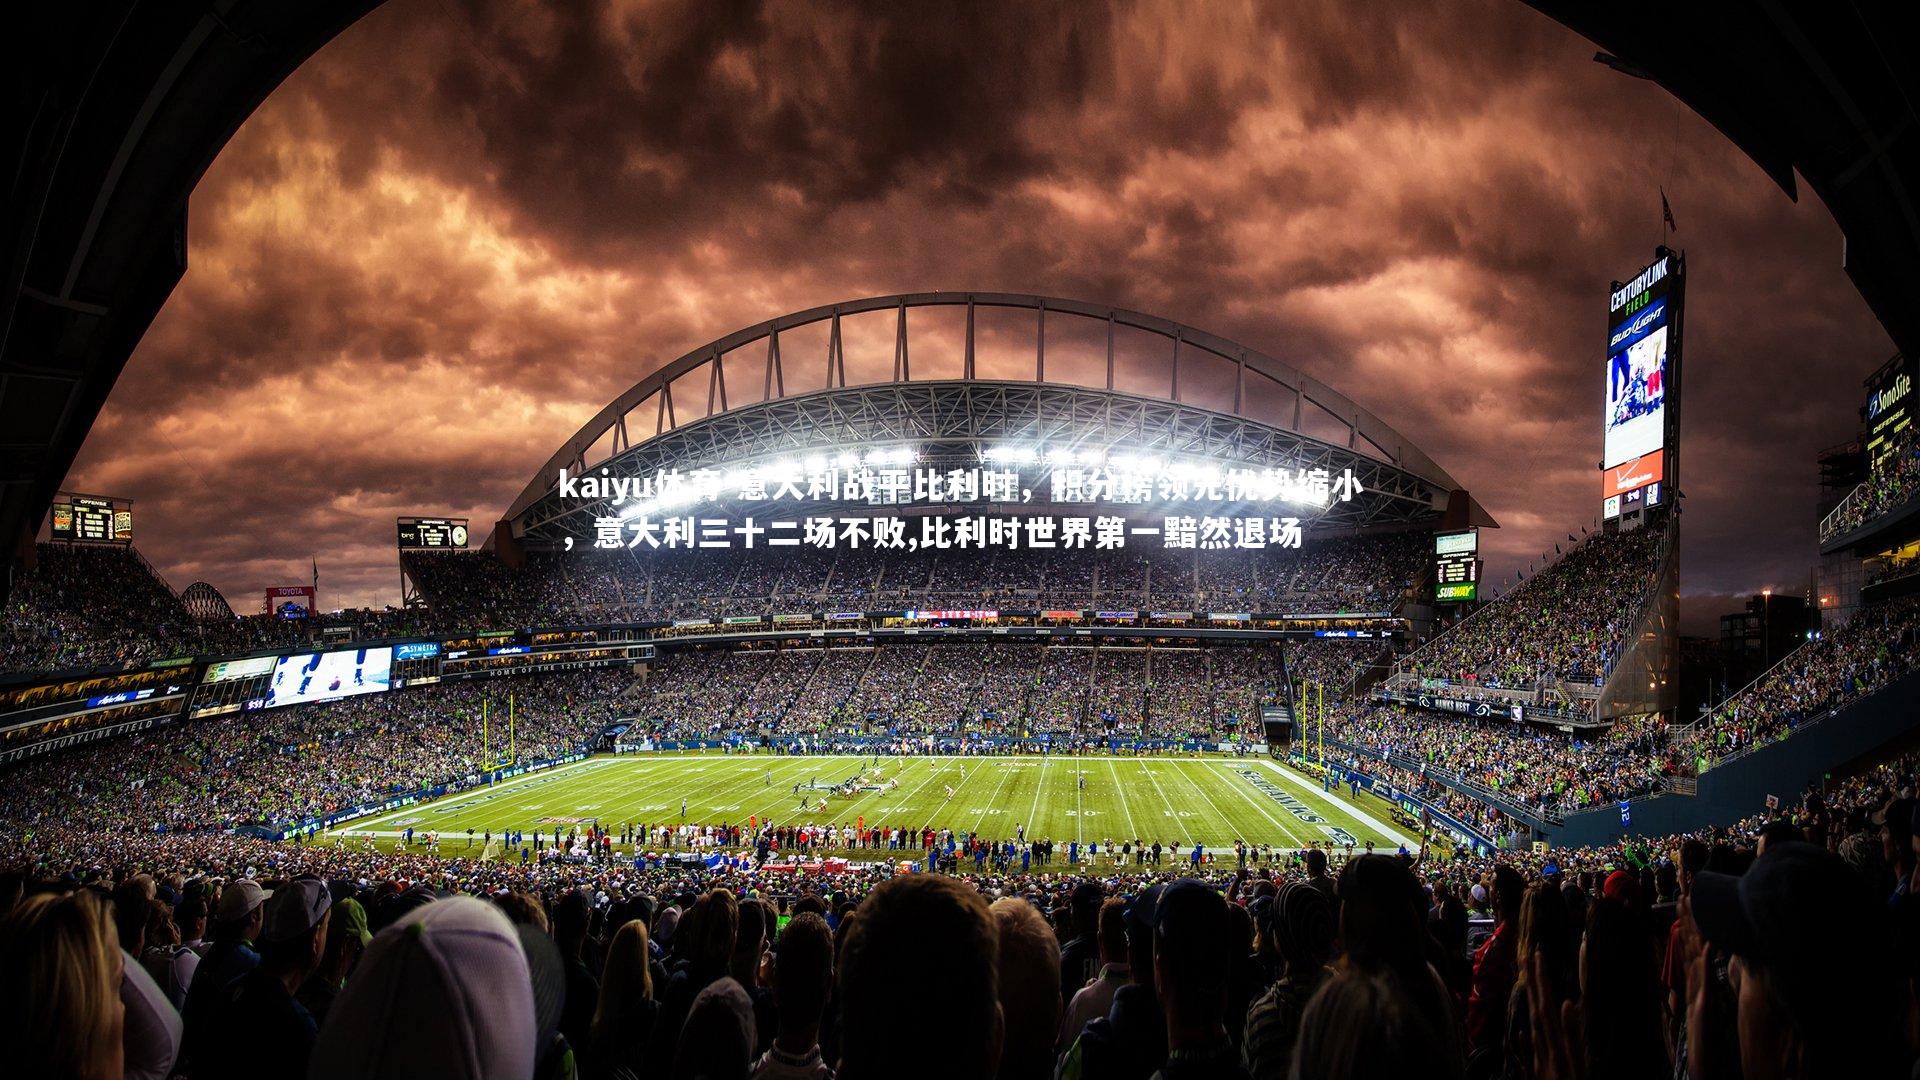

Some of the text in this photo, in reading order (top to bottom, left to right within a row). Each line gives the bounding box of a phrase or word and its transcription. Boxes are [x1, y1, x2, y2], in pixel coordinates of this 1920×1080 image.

[1610, 256, 1669, 313] CENTURYLINK
[1625, 290, 1650, 316] FIELD
[1610, 305, 1665, 347] BUD LIGHT
[1878, 373, 1911, 414] SonoSite
[279, 588, 303, 596] TOYOTA
[1437, 585, 1475, 598] SUBWAY
[30, 729, 112, 756] CENTURYLINK
[118, 720, 152, 734] FIELD
